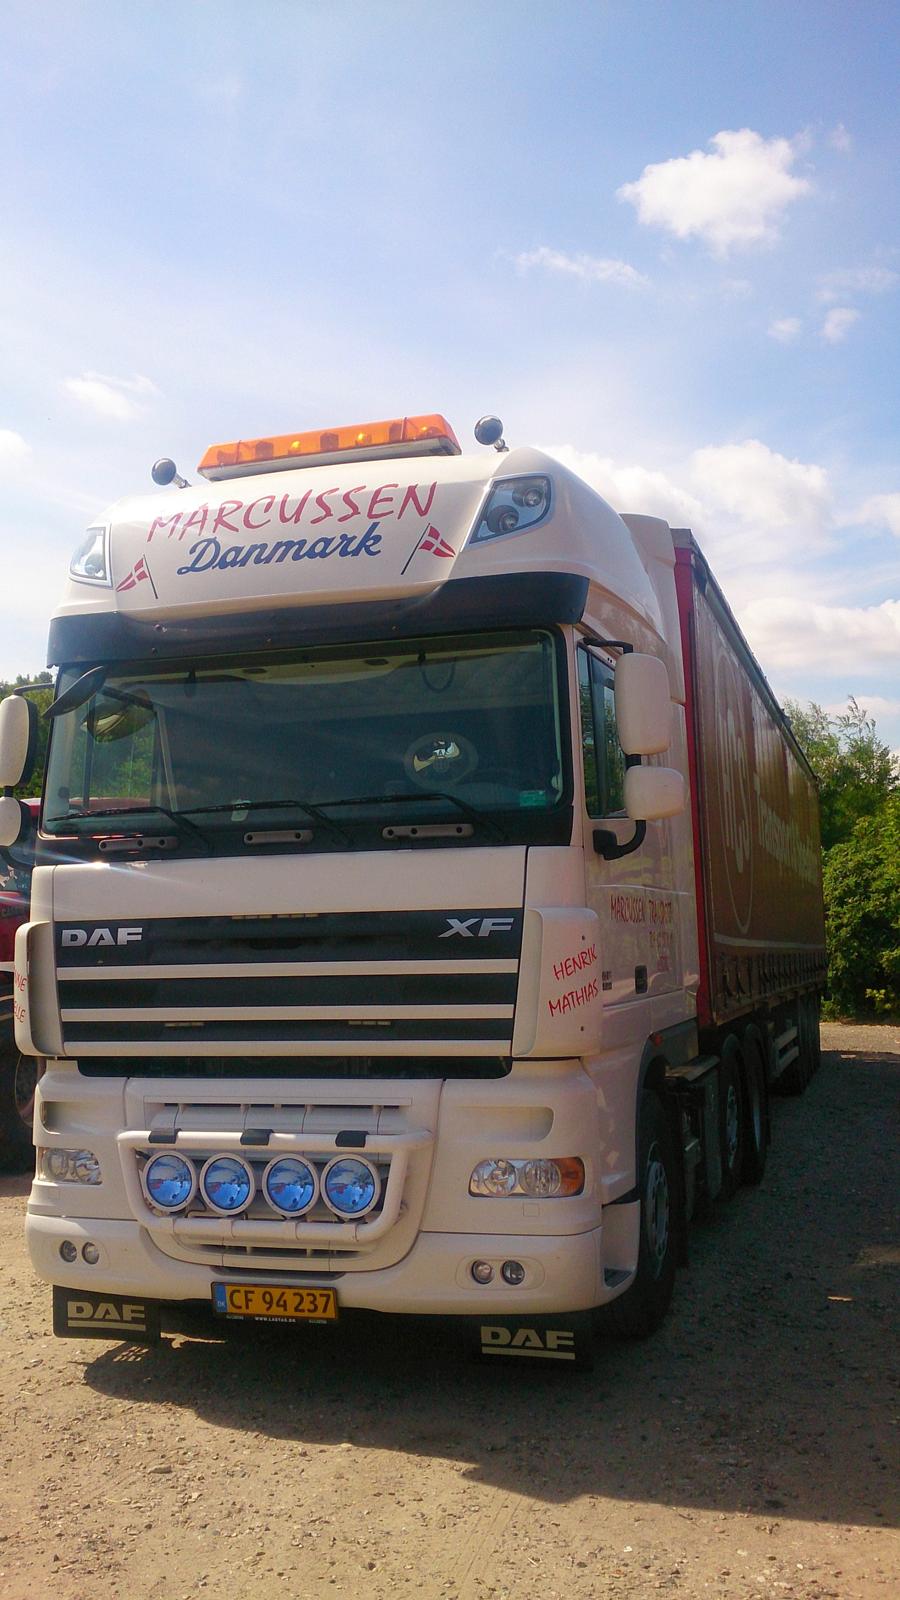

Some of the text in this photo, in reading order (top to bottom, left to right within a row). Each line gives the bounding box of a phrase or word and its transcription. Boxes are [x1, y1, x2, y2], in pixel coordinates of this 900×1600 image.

[147, 481, 438, 543] MARCUSSEN
[176, 522, 382, 576] Danmark
[60, 926, 143, 947] DAF
[437, 917, 515, 938] XF
[553, 943, 597, 981] HENRIK
[548, 978, 599, 1017] MATHIAS
[67, 1301, 145, 1320] DAF
[229, 1289, 331, 1314] CF 94 237
[481, 1326, 575, 1349] DAF
